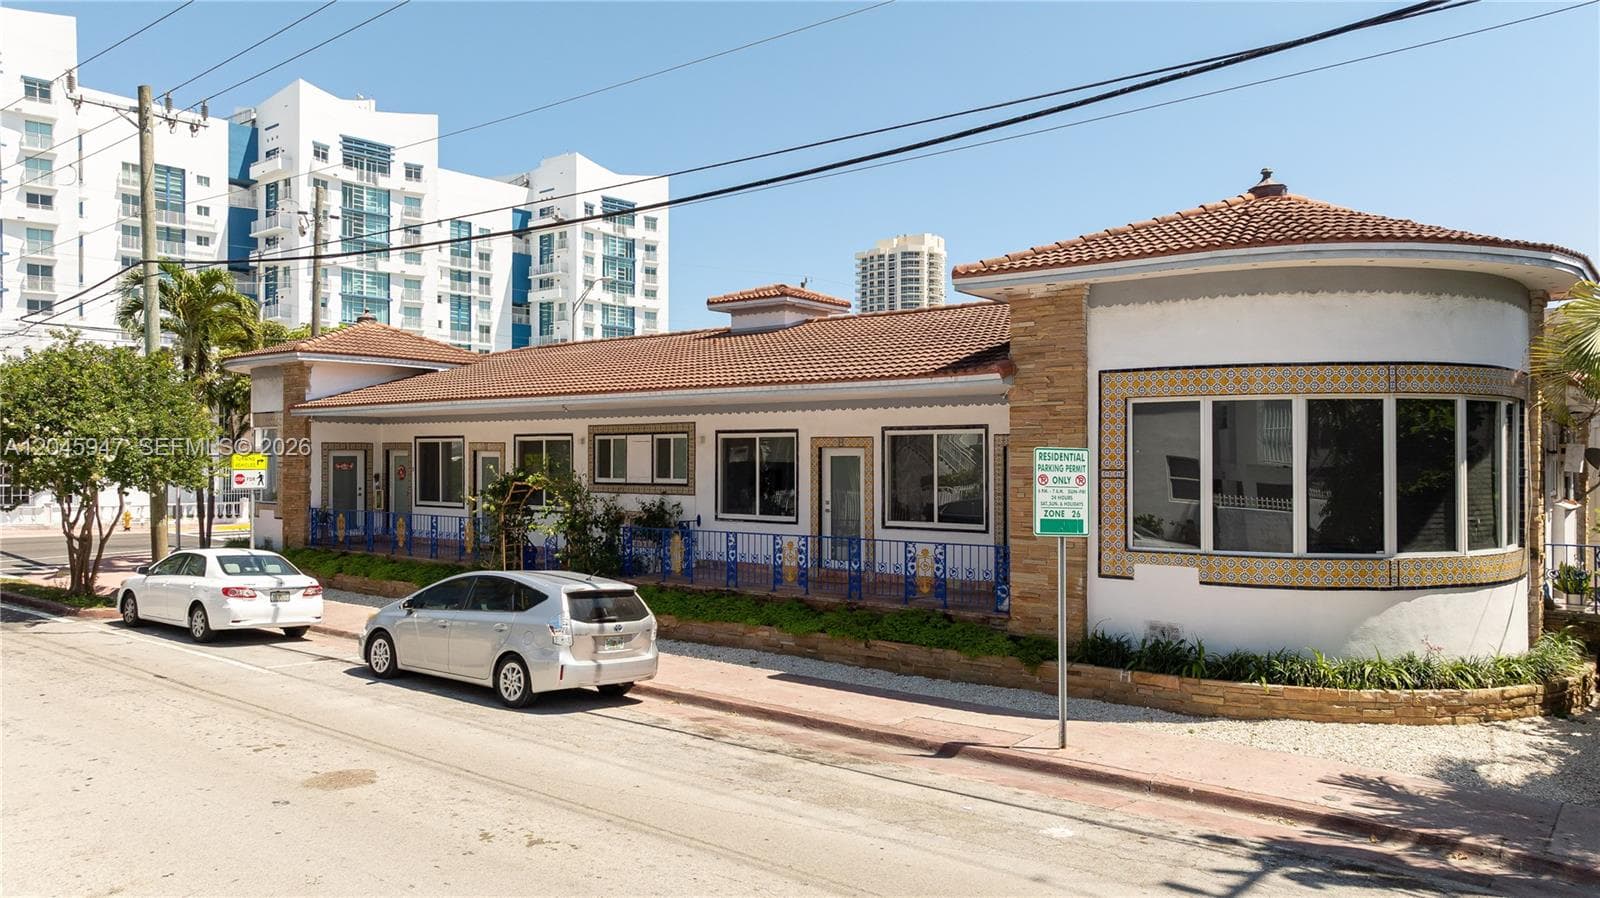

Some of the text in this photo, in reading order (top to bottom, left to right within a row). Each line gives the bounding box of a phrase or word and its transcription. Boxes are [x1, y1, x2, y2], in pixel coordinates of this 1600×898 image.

[1039, 452, 1086, 461] RESIDENTIAL
[1037, 463, 1086, 473] PARKING PERMIT
[1052, 476, 1071, 484] ONLY
[1043, 509, 1081, 518] ZONE 26
